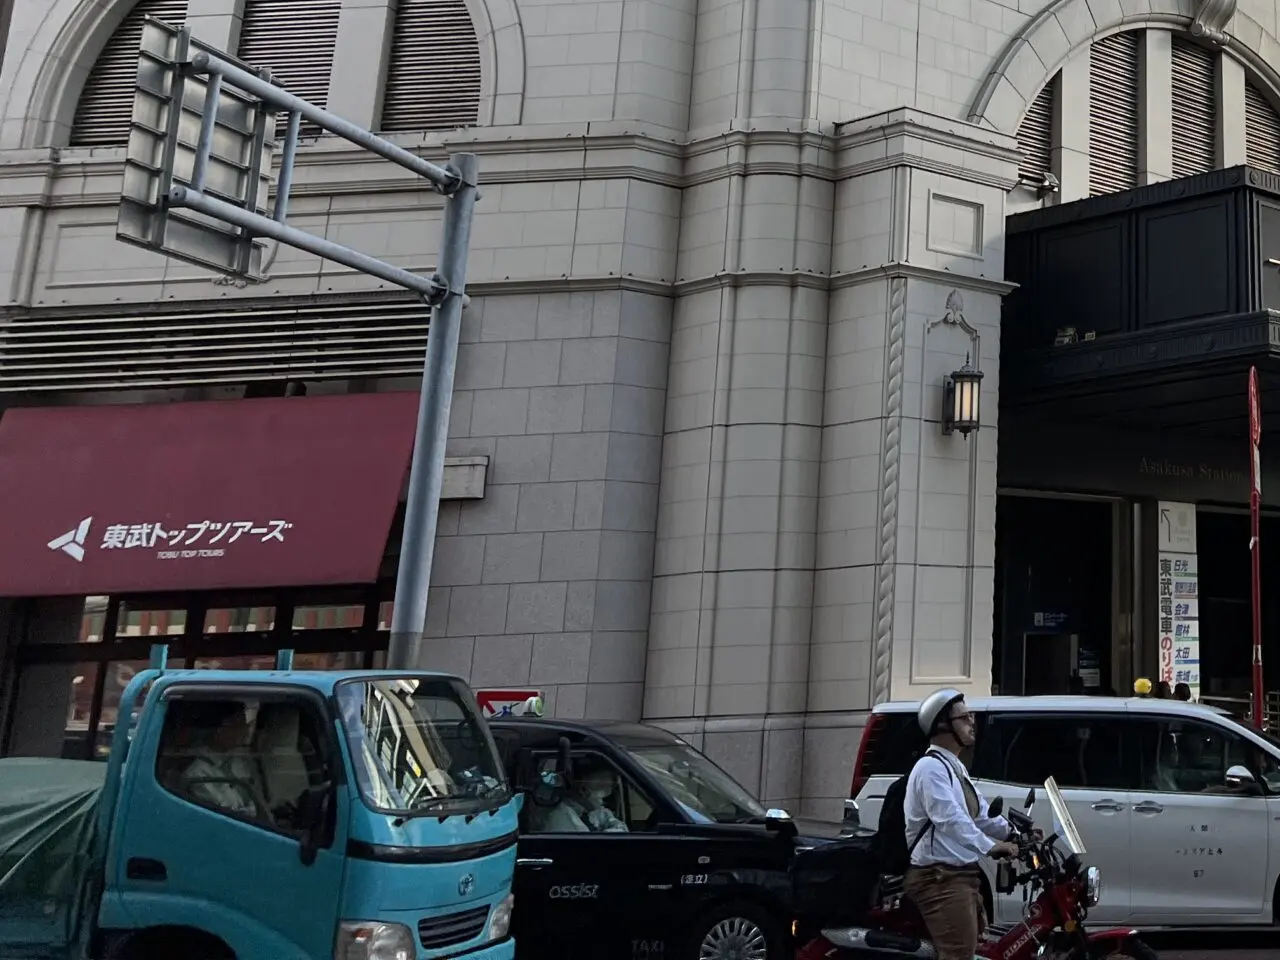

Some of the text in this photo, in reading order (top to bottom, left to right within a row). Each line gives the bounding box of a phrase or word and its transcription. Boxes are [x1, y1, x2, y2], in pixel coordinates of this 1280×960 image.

[100, 519, 293, 549] 東武トップツアーズ
[157, 548, 225, 559] TOBU TOP TOURS
[1174, 560, 1188, 572] 日光
[1175, 603, 1189, 616] 会津
[1175, 647, 1190, 659] 太田
